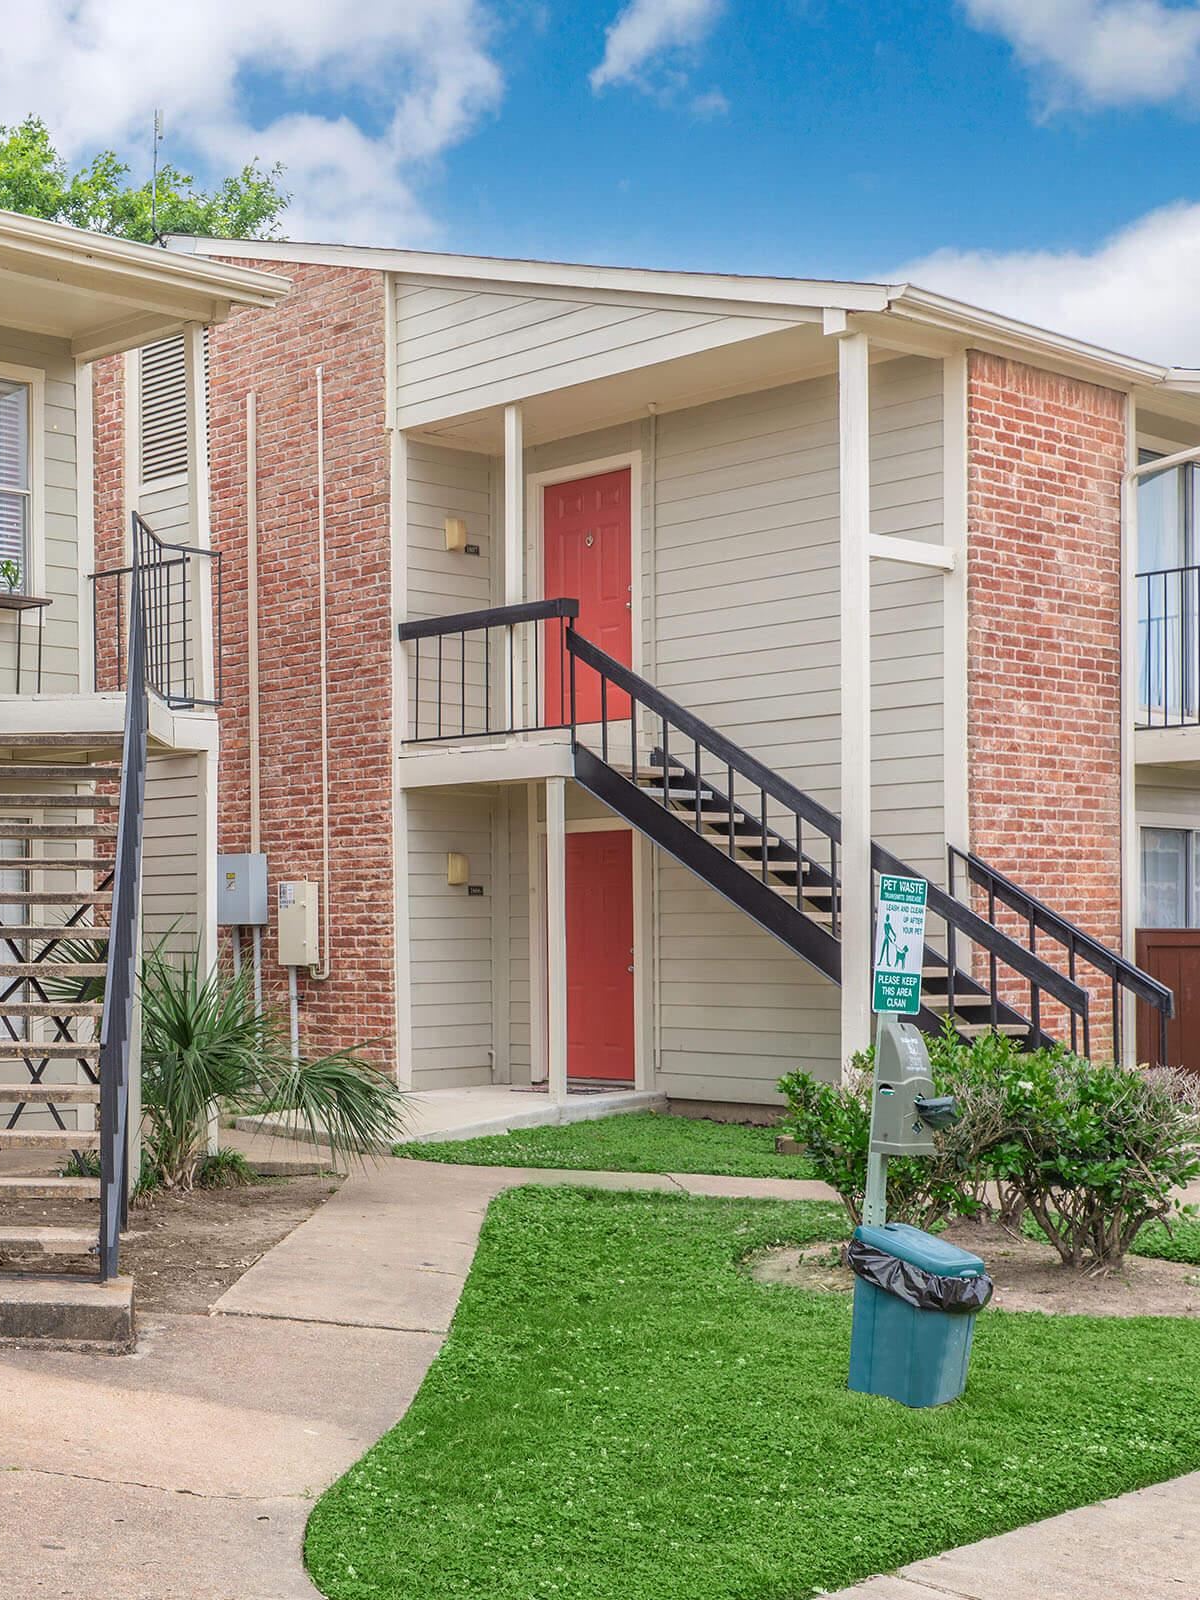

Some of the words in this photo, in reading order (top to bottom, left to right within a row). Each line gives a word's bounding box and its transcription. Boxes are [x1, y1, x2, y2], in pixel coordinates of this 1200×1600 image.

[883, 879, 897, 891] PET
[899, 881, 924, 894] WASTE
[910, 906, 924, 914] CLEAN
[878, 974, 901, 985] PLEASE
[901, 976, 918, 986] KEEP
[882, 986, 895, 996] THIS
[896, 987, 913, 997] AREA
[886, 998, 906, 1008] CLEAN
